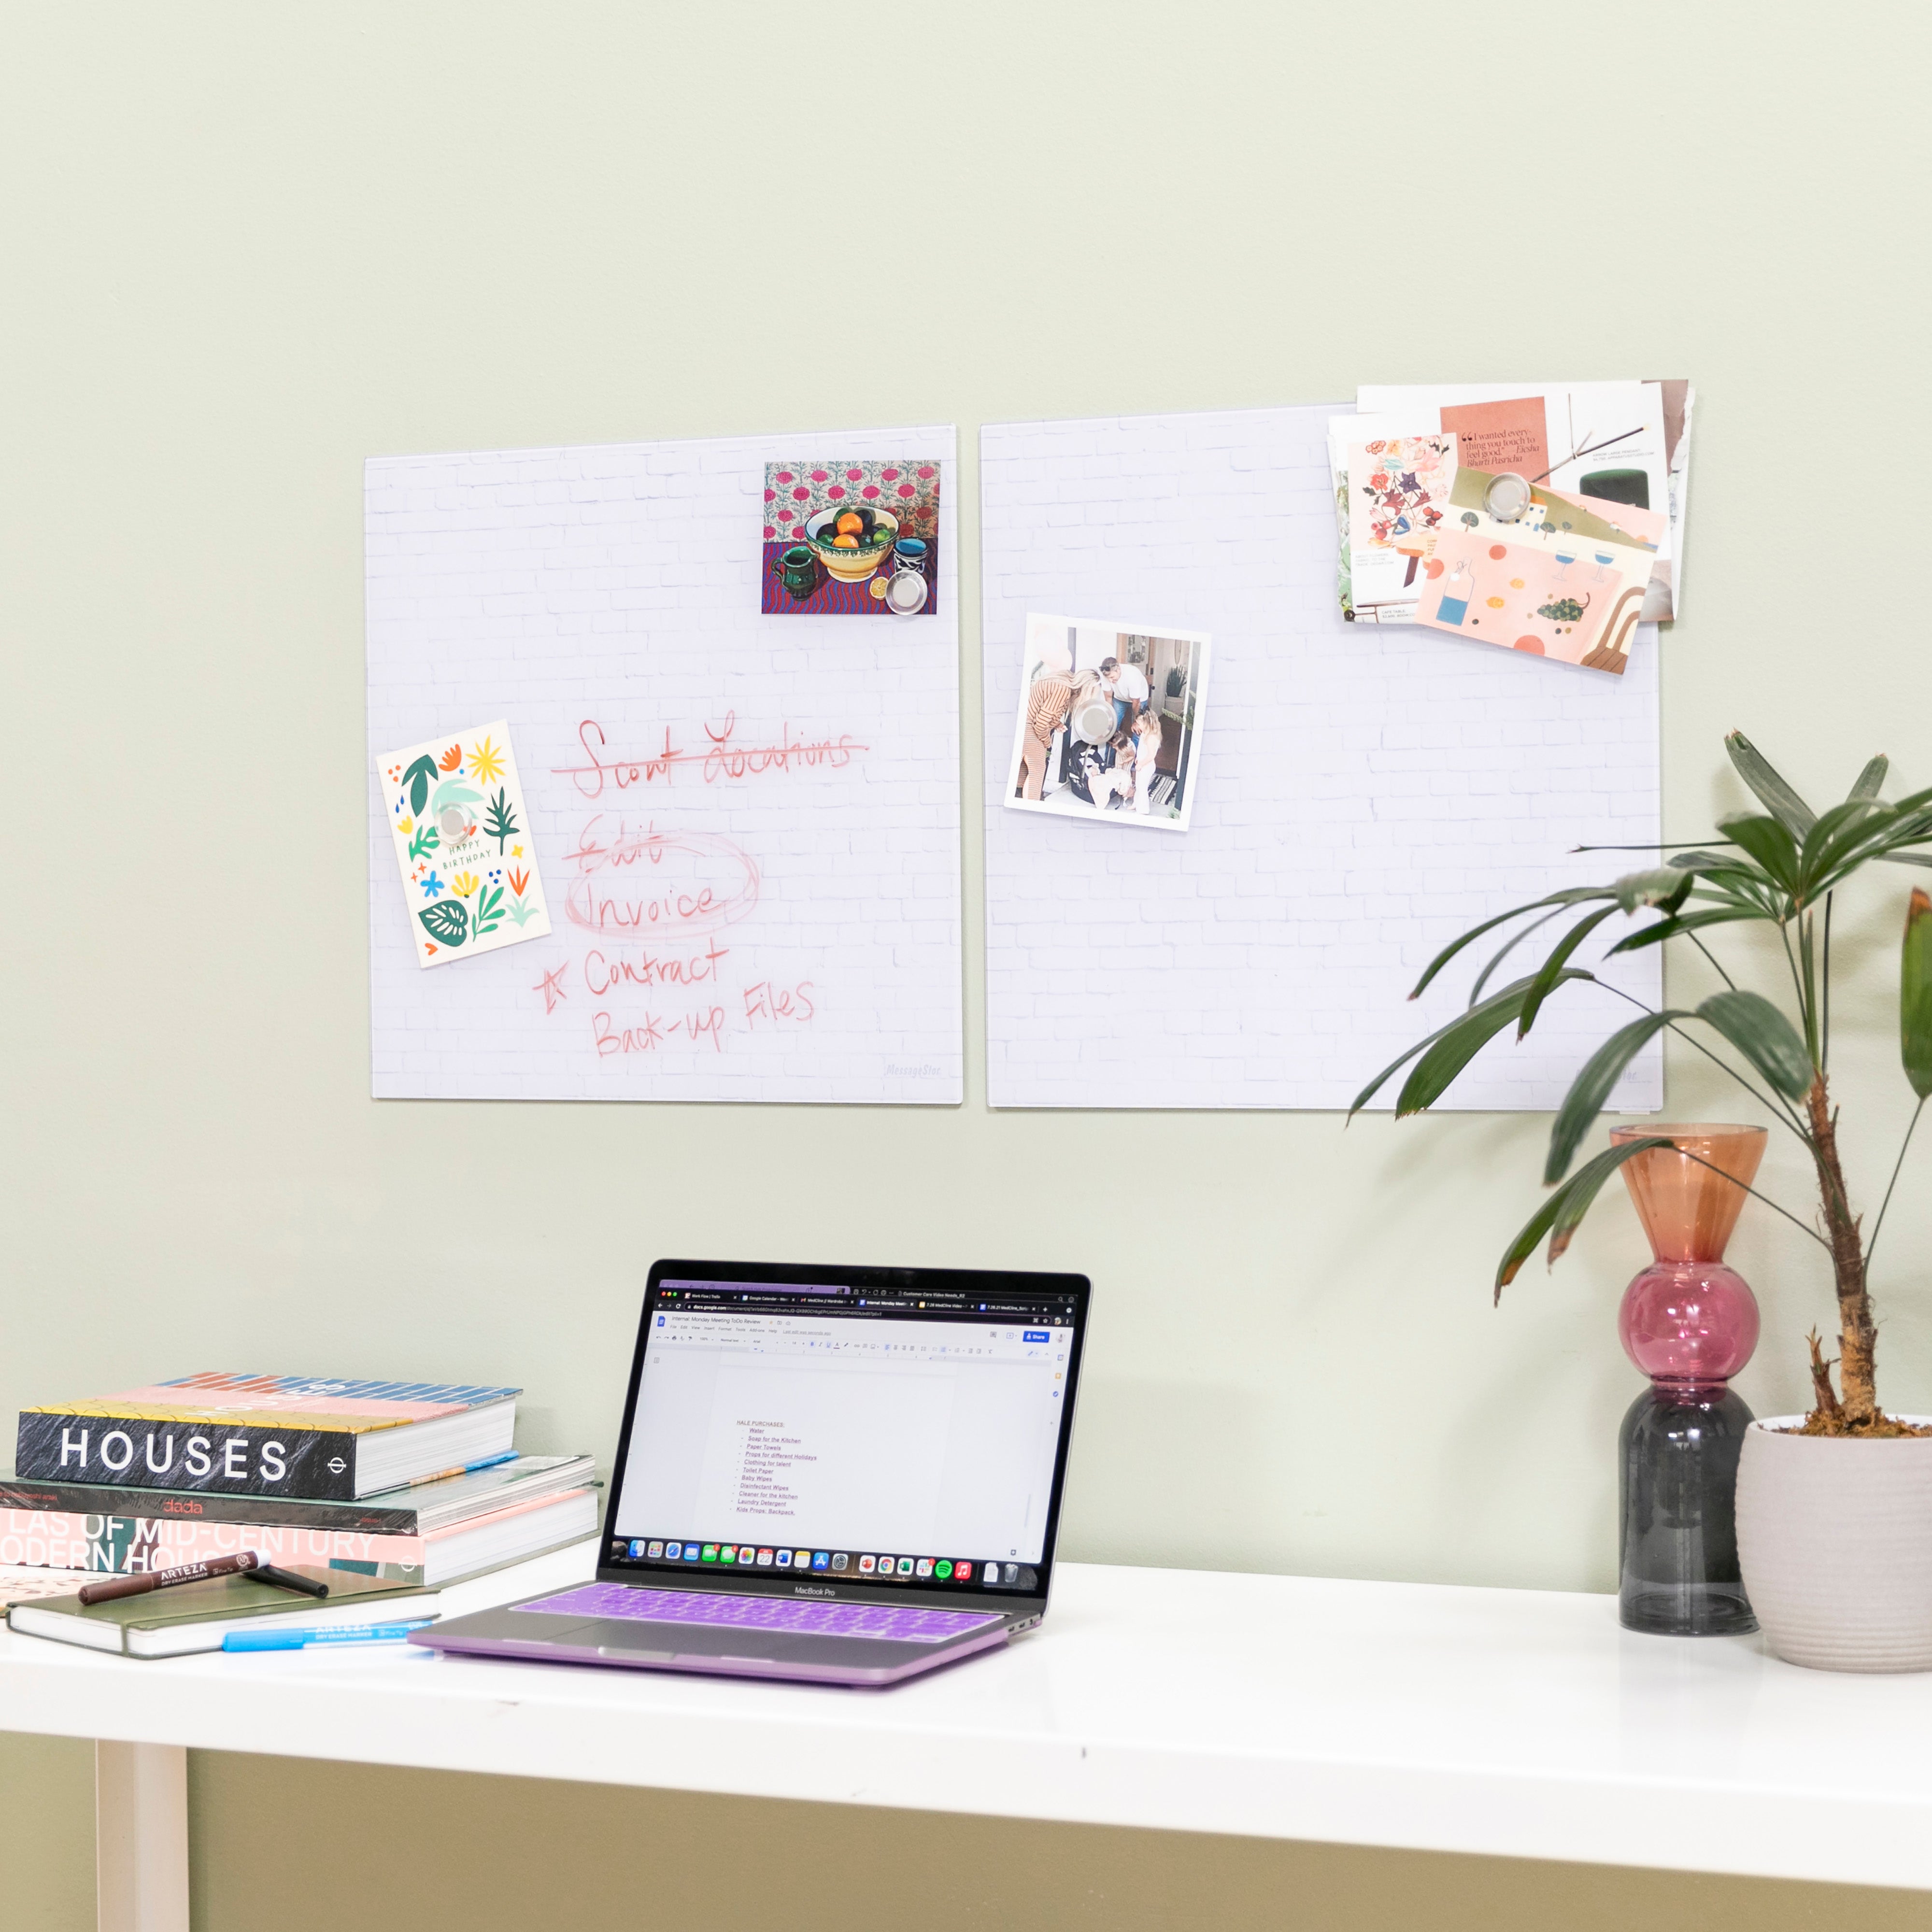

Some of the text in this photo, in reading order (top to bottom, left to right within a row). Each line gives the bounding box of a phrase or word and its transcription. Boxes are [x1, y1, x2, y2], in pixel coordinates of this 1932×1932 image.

[1466, 441, 1486, 451] thing
[1488, 441, 1501, 450] you
[1504, 437, 1525, 446] touch
[1479, 430, 1506, 440] wanted
[1466, 449, 1480, 458] feel
[1467, 455, 1522, 467] Bharti Pasricha
[703, 710, 853, 783] Locations
[449, 839, 479, 855] HAPPY
[579, 814, 664, 869] Edit
[442, 850, 491, 869] BIRTHDAY
[587, 883, 722, 927] Invoice
[584, 937, 730, 995] Contract
[592, 981, 815, 1058] Back-up Files
[887, 1064, 940, 1078] MessageStor
[184, 1384, 346, 1416] HOUSES
[60, 1428, 286, 1481] HOUSES
[163, 1500, 202, 1514] dada
[80, 1514, 124, 1541] OF
[136, 1518, 375, 1559] MID-CENTURY
[161, 1563, 207, 1580] ARTEZA
[795, 1587, 824, 1595] MacBook
